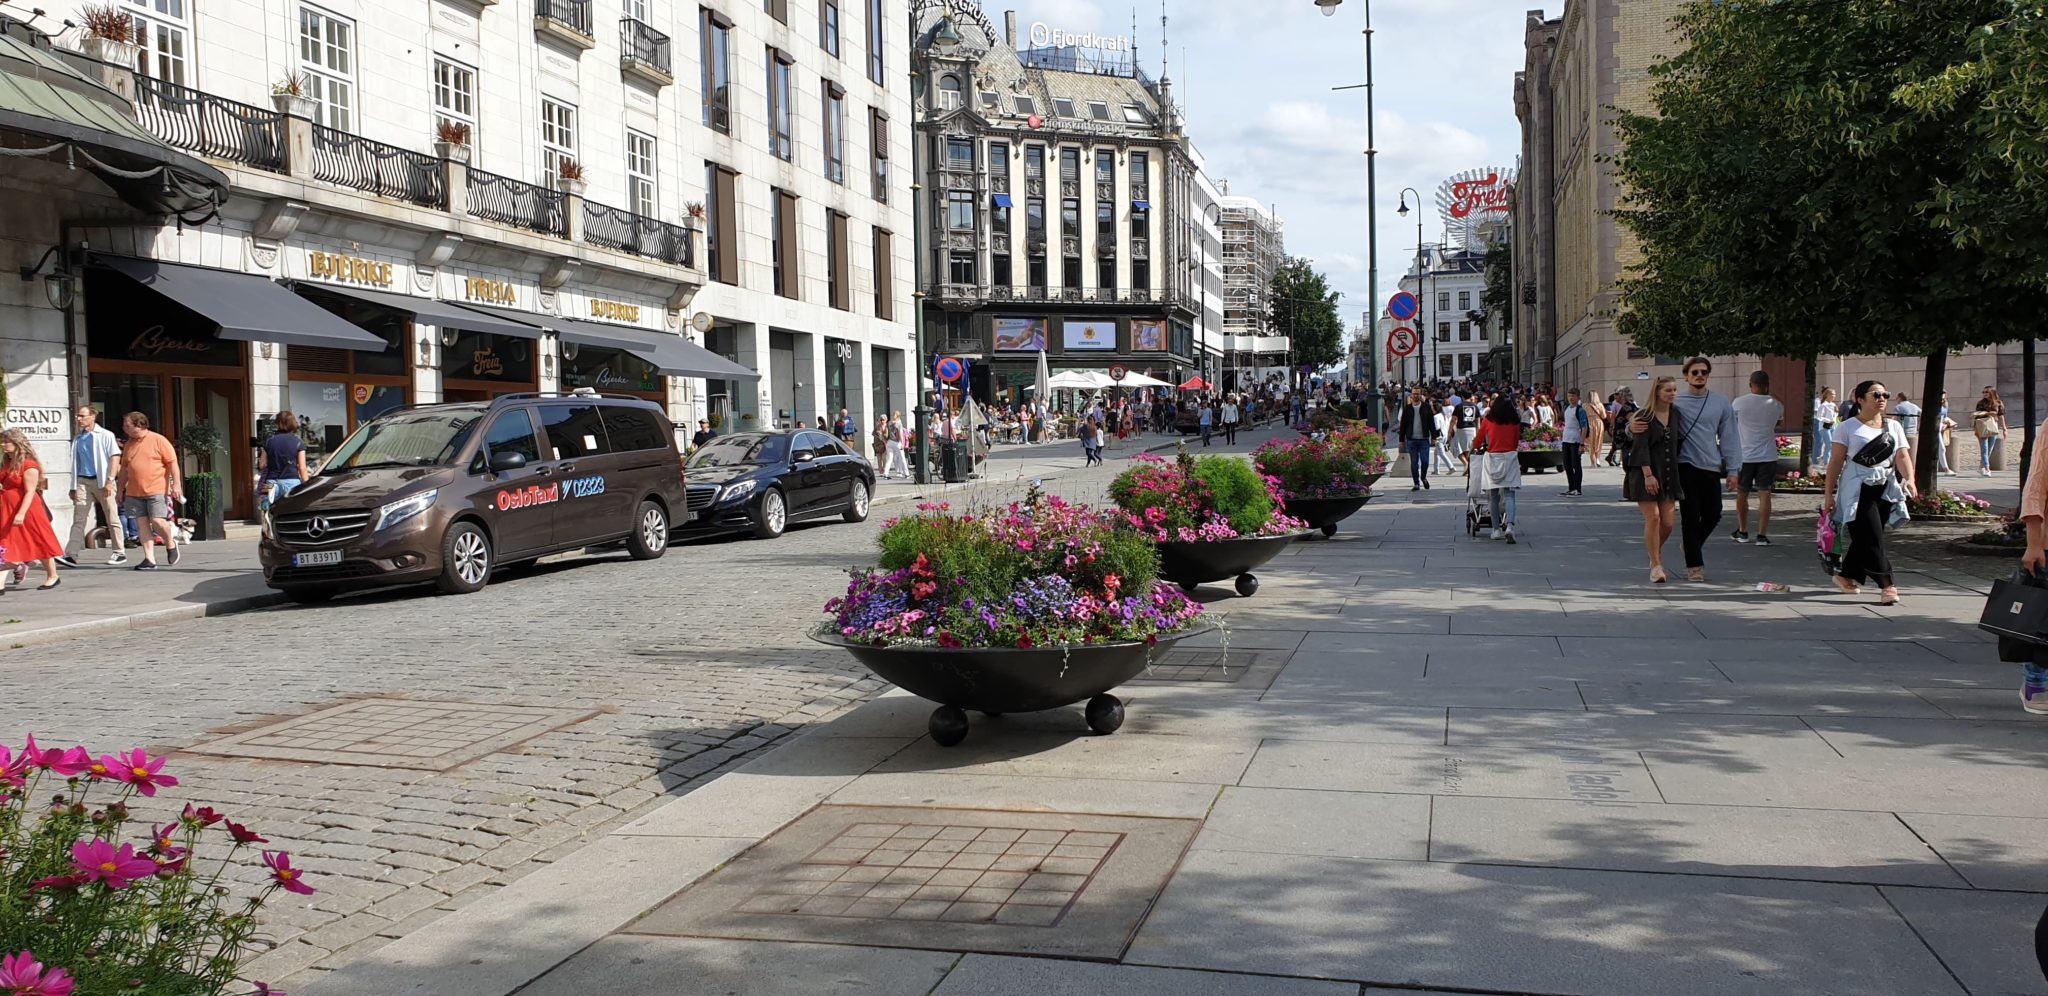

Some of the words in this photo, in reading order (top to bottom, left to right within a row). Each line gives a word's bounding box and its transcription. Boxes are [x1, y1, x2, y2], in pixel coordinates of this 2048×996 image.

[1052, 28, 1128, 51] Fjordkraft
[1450, 173, 1511, 218] Frei
[310, 250, 393, 288] BJERKE
[465, 276, 516, 306] FREIA
[591, 298, 640, 323] BJERKE
[128, 324, 211, 357] Bjerke
[837, 339, 852, 363] DNB
[472, 347, 503, 375] Freia
[595, 367, 630, 387] Bjerke
[6, 409, 63, 424] GRAND
[496, 480, 559, 511] OsloTaxi
[573, 475, 604, 498] 02323
[299, 554, 309, 564] BT
[313, 551, 338, 563] 83911
